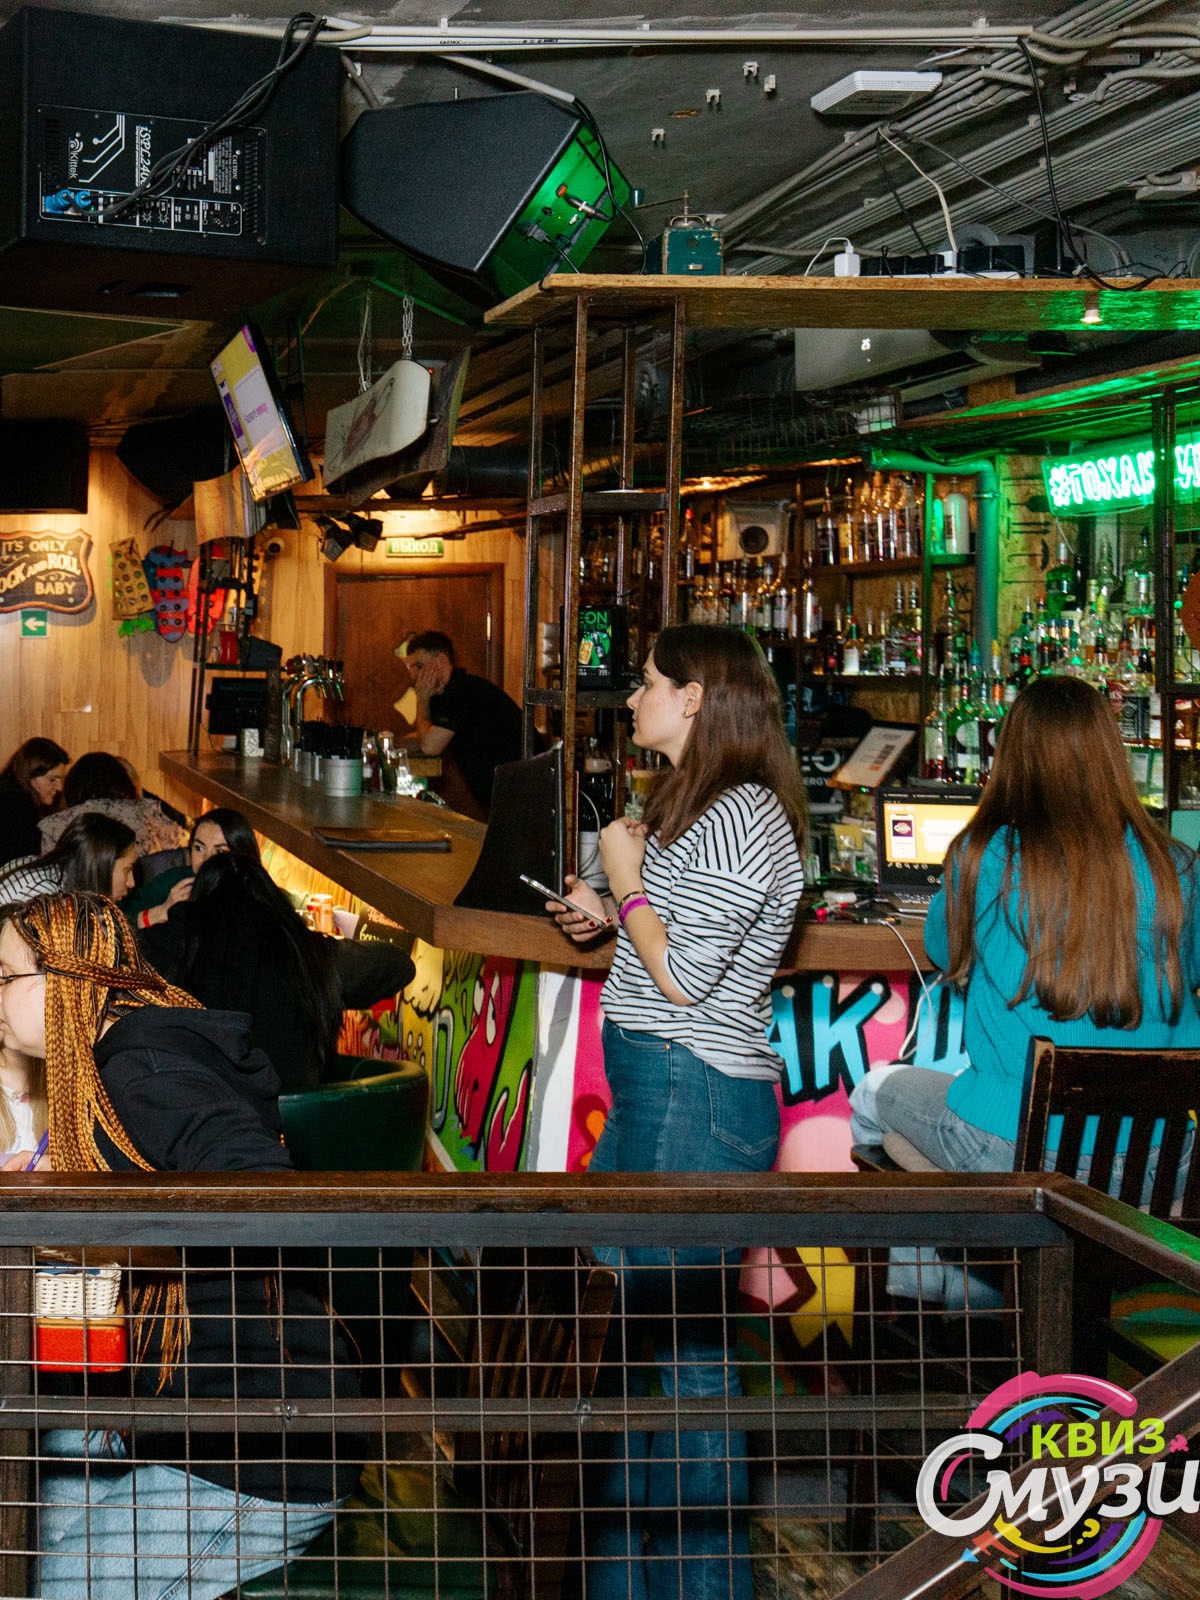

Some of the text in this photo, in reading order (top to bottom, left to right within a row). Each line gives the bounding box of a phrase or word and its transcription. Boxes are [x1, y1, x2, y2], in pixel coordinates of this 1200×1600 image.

[69, 152, 79, 179] Kittek
[2, 540, 68, 553] IT'S ONLY
[391, 541, 439, 553] ВЫХОД
[27, 559, 48, 577] AND
[47, 552, 81, 575] ROLL
[34, 581, 76, 596] BABY
